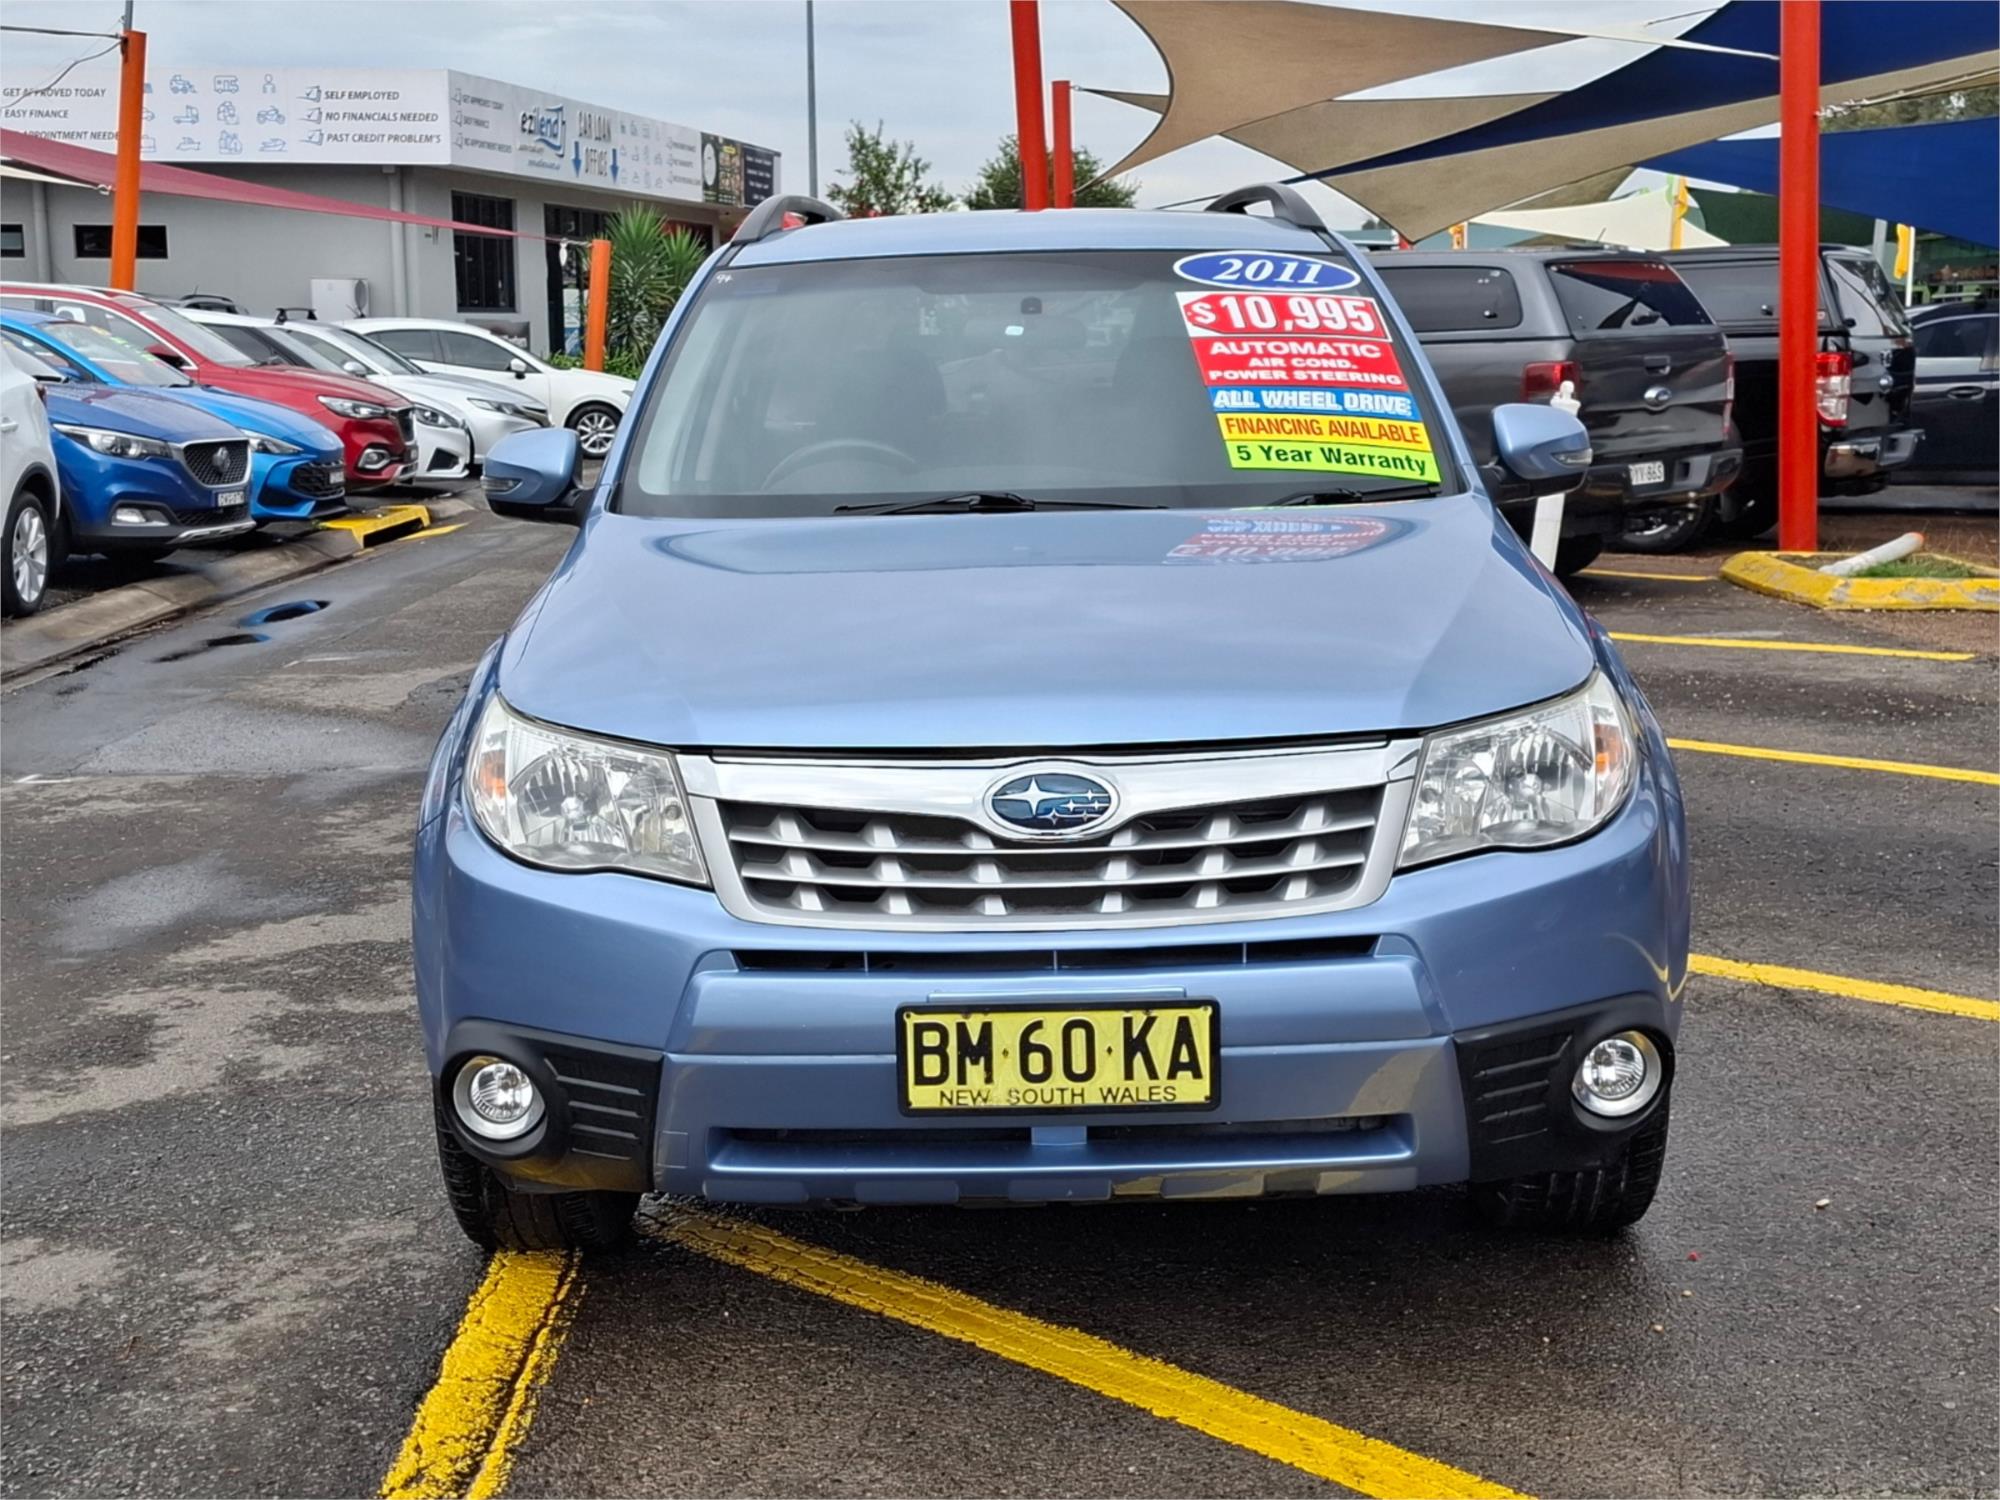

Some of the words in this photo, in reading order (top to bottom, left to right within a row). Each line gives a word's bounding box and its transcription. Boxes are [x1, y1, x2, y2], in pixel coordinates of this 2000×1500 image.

[2, 88, 21, 97] GET
[74, 88, 107, 97] TODAY
[324, 91, 346, 100] SELF
[348, 91, 400, 100] EMPLOYED
[4, 109, 27, 118] EASY
[28, 109, 70, 119] FINANCE
[325, 112, 340, 121] NO
[342, 112, 398, 122] FINANCIALS
[399, 113, 439, 122] NEEDED
[90, 131, 120, 140] NEEDE
[327, 133, 350, 143] PAST
[352, 133, 386, 143] CREDIT
[387, 134, 442, 143] PROBLEM'S
[1212, 258, 1325, 285] 2011
[1190, 295, 1376, 332] $10,995
[1210, 341, 1382, 359] AUTOMATIC
[1248, 357, 1286, 368] AIR
[1291, 358, 1359, 370] COND.
[1208, 369, 1289, 381] POWER
[1292, 370, 1402, 385] STEERING
[1213, 389, 1260, 409] ALL
[1261, 390, 1343, 412] WHEEL
[1343, 392, 1412, 416] DRIVE
[1224, 416, 1323, 436] FINANCING
[1328, 419, 1424, 445] AVAILABLE
[1236, 444, 1252, 461] 5
[1258, 444, 1313, 463] Year
[1320, 446, 1426, 476] Warranty
[940, 1089, 991, 1106] NEW
[1009, 1087, 1085, 1105] SOUTH
[1099, 1085, 1178, 1103] WALES
